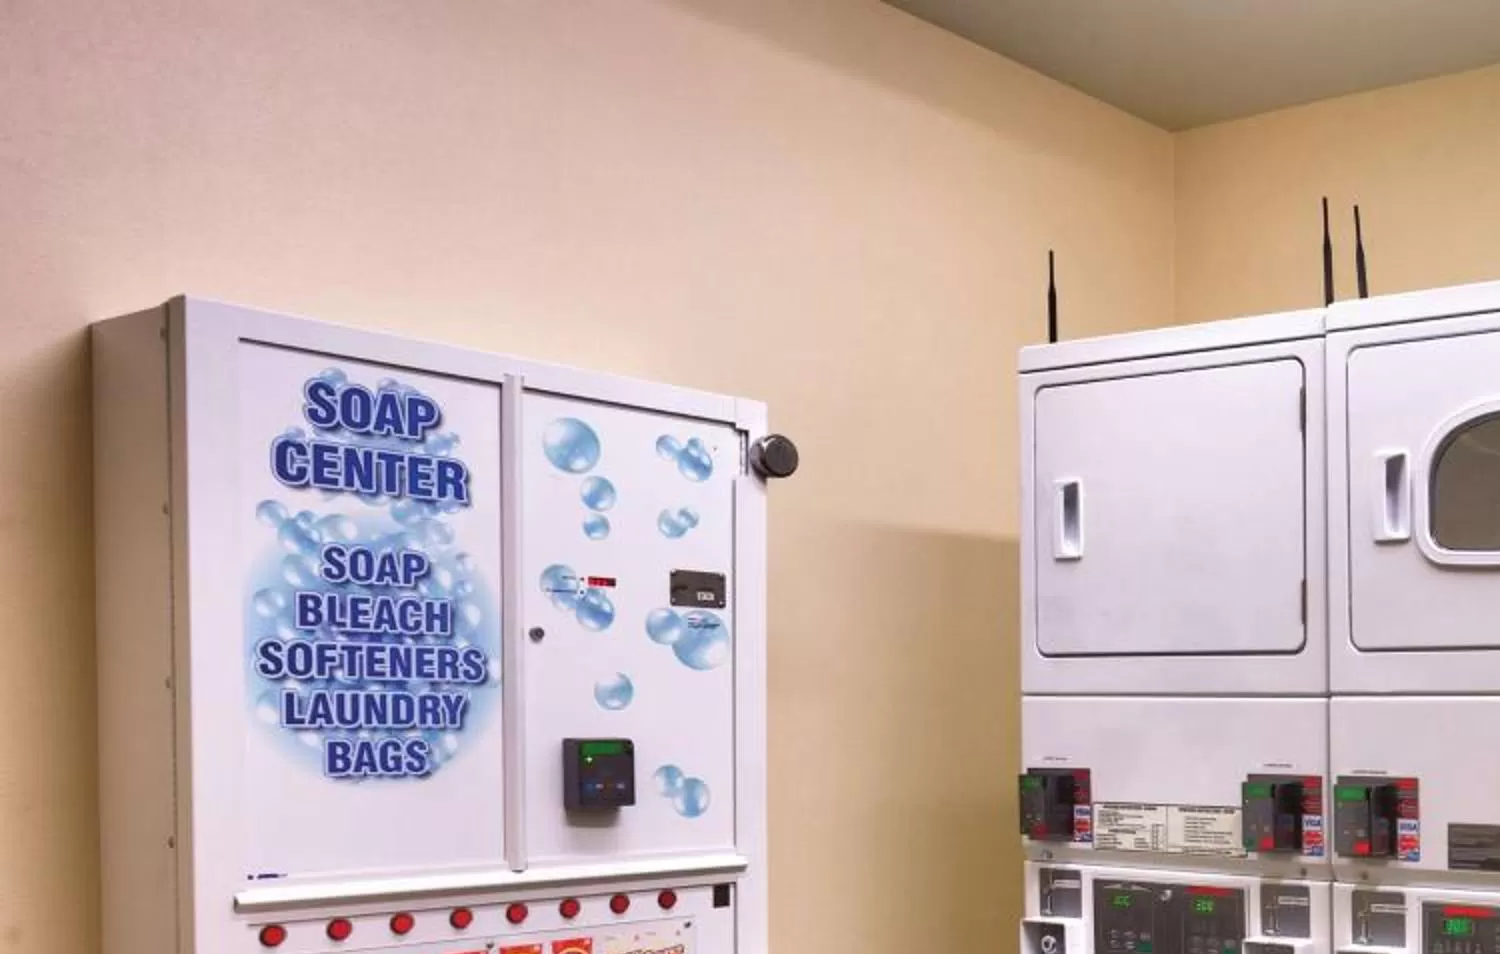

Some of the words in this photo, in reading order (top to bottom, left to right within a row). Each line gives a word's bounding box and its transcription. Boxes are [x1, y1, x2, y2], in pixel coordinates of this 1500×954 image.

[305, 379, 438, 439] SOAP
[272, 437, 467, 502] CENTER
[321, 544, 427, 586] SOAP
[298, 592, 450, 634] BLEACH
[257, 639, 485, 682] SOFTENERS
[283, 690, 465, 727] LAUNDRY
[326, 738, 430, 775] BAGS
